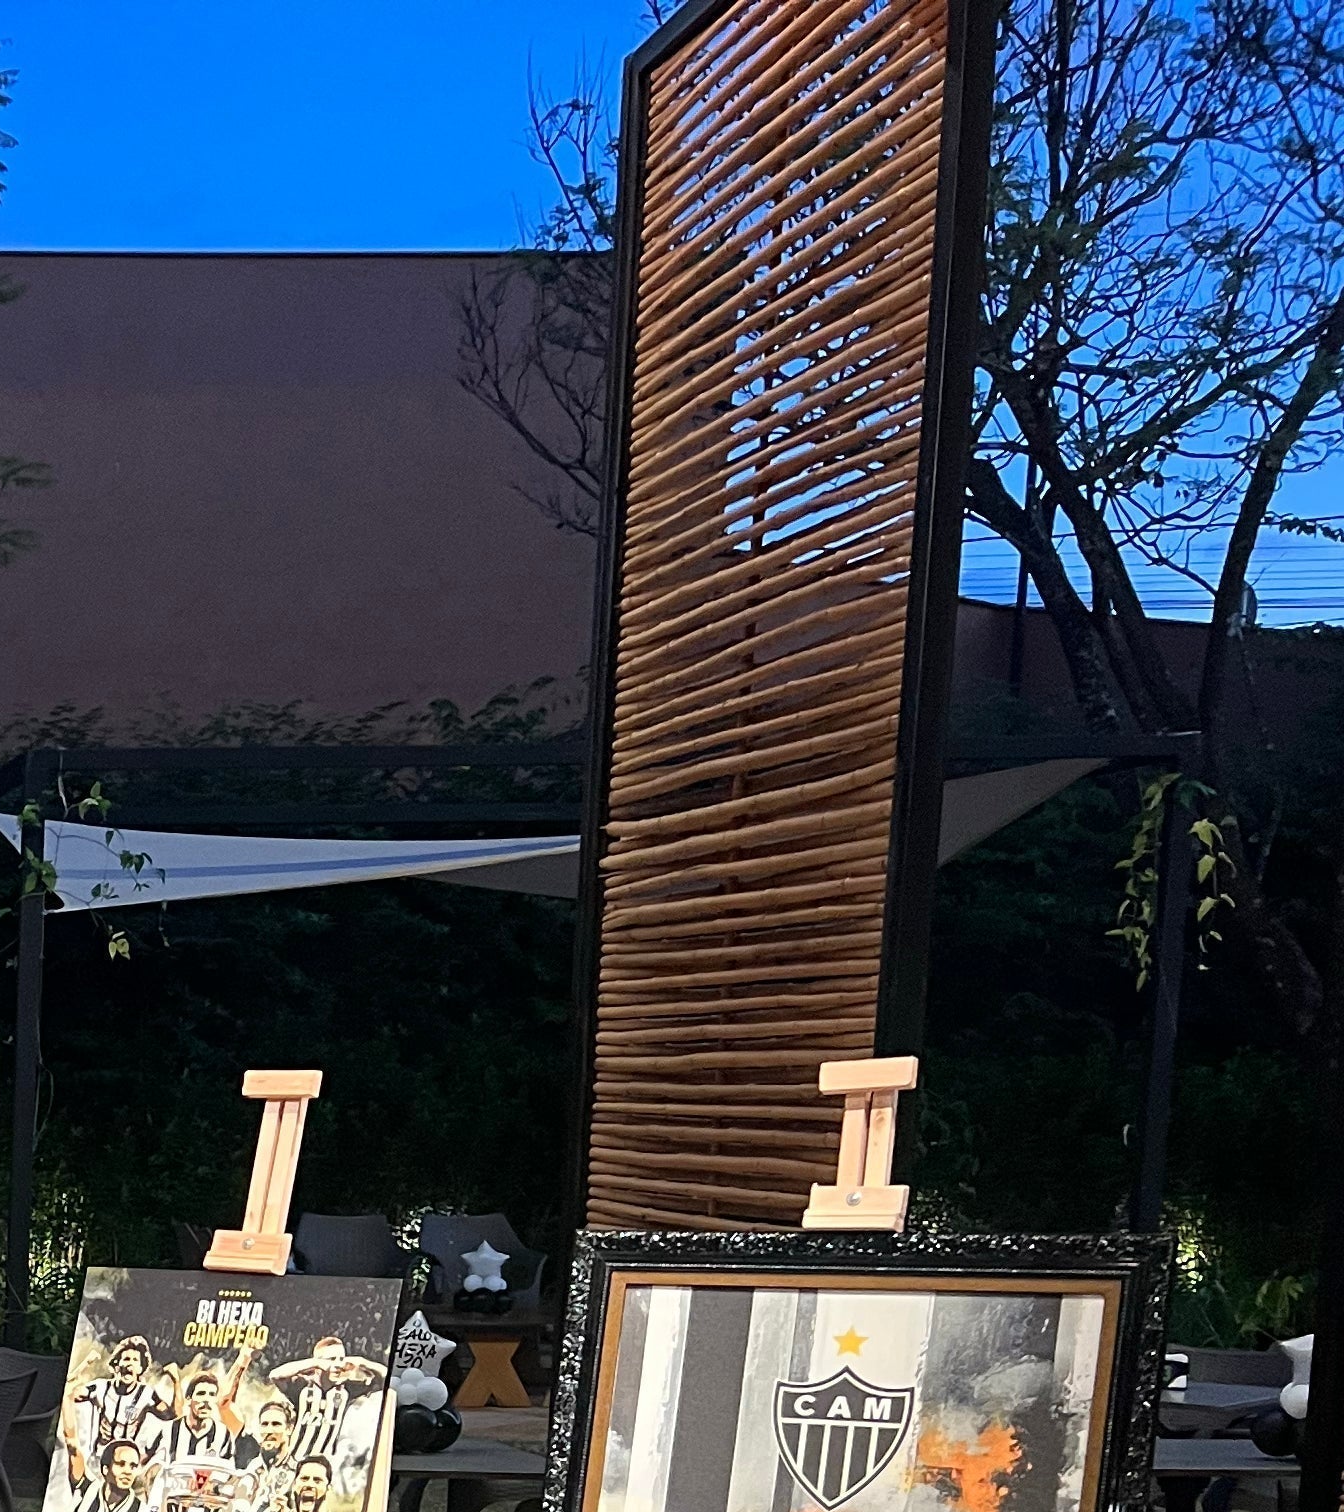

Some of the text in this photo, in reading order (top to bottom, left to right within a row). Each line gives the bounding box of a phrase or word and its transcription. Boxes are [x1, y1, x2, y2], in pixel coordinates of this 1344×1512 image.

[196, 1300, 264, 1327] BI HEXA
[794, 1395, 892, 1421] CAM
